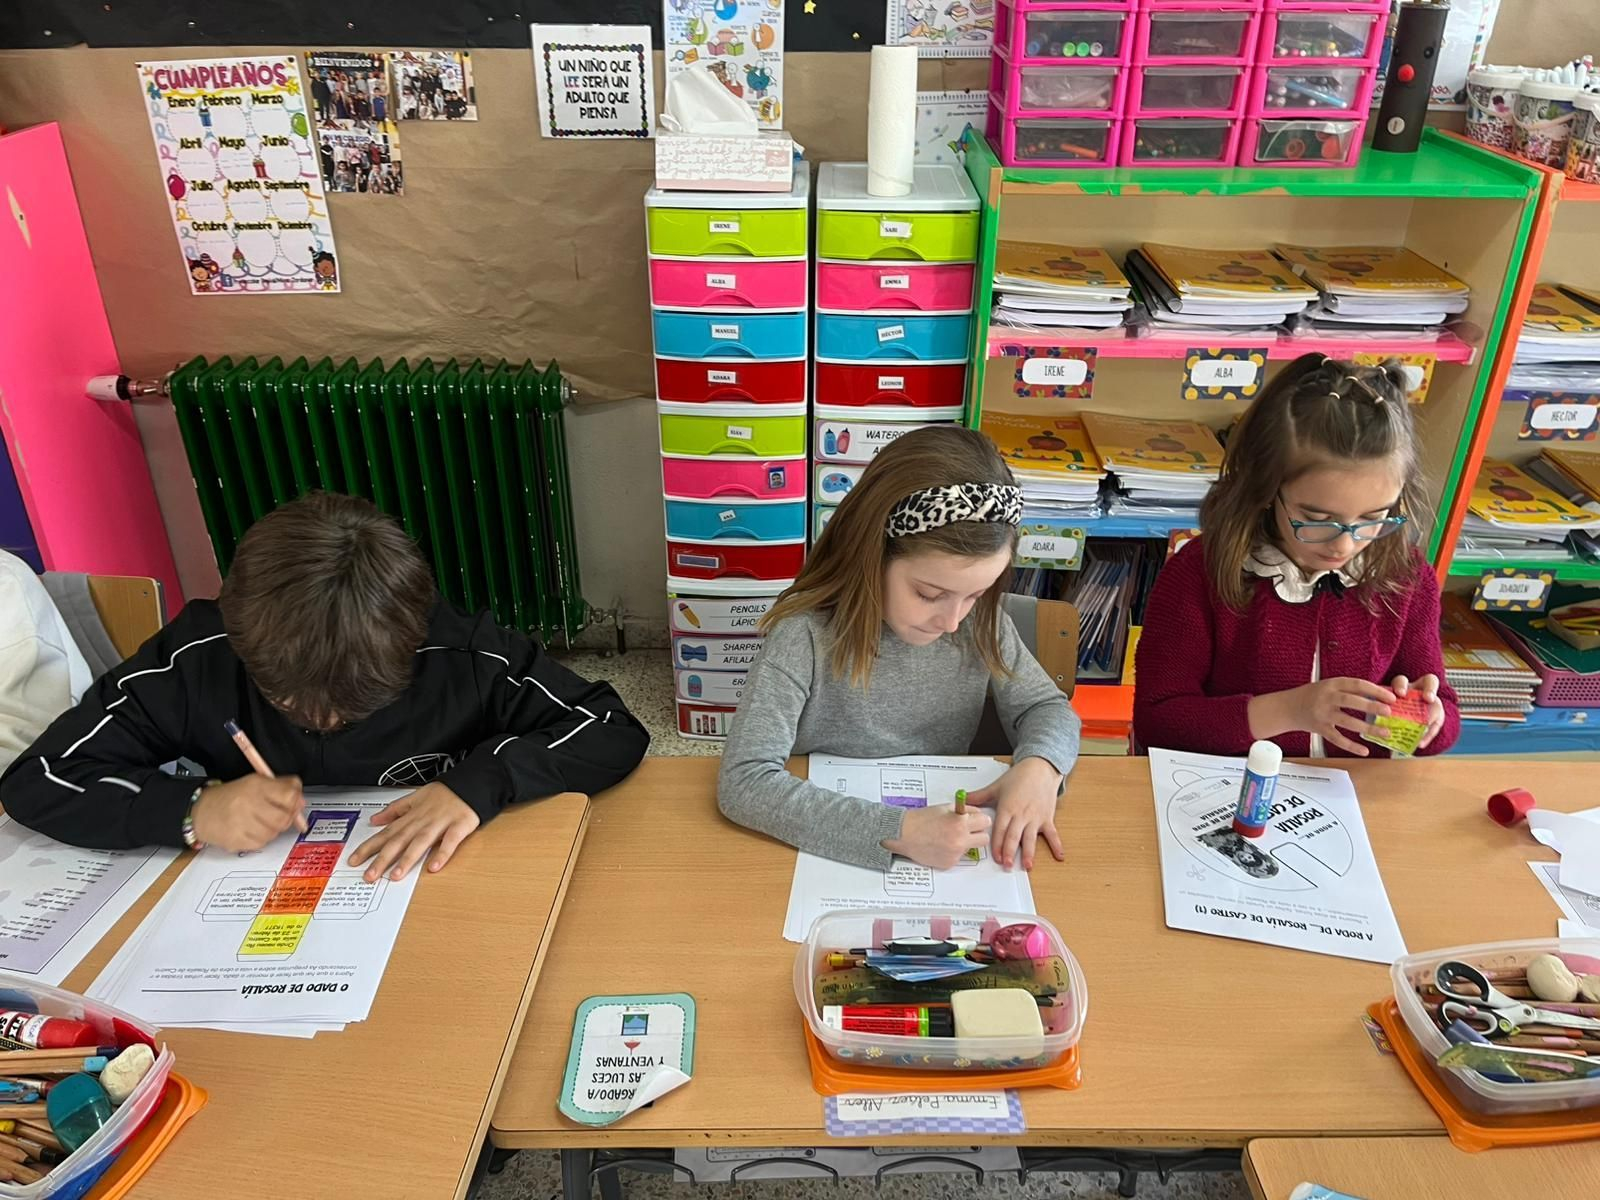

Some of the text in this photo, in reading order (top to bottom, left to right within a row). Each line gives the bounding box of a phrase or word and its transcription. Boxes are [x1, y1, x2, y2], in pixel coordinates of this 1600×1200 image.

[314, 57, 372, 68] BIENVENIDOS
[558, 57, 632, 73] UN NIÑO QUE
[154, 61, 288, 91] CUMPLEAÑOS
[563, 75, 580, 88] LEE
[611, 76, 629, 88] UN
[168, 97, 196, 108] Enero
[202, 94, 242, 106] Febrero
[252, 93, 284, 105] Marzo
[565, 91, 630, 104] ADULTO QUE
[579, 107, 618, 119] PIENSA
[180, 138, 202, 149] Abril
[219, 136, 246, 150] Mayo
[262, 135, 290, 147] Junio
[191, 181, 214, 191] Julio
[228, 180, 260, 192] Agosto
[264, 181, 310, 192] Septiembre
[192, 222, 228, 232] Octubre
[235, 222, 272, 231] Noviembre
[278, 222, 312, 231] Diciembre
[715, 327, 738, 335] MANUEL
[1044, 365, 1066, 378] IRENE
[1214, 364, 1233, 378] ALBA
[1032, 540, 1055, 552] ADARA
[730, 604, 767, 614] PENCILS
[1283, 795, 1306, 808] DE
[1273, 807, 1324, 836] ROSALÍA
[1195, 904, 1207, 915] (1)
[1210, 908, 1247, 920] CASTRO
[1249, 914, 1263, 923] DE
[1265, 916, 1307, 930] ROSALÍA
[1334, 928, 1363, 940] RODA
[1365, 933, 1373, 941] A
[241, 983, 349, 999] O DADO DE ROSALÍA
[596, 1056, 664, 1068] Y VENTANAS
[592, 1072, 625, 1083] LUCES
[843, 1097, 883, 1112] Aller
[944, 1095, 999, 1110] Emma
